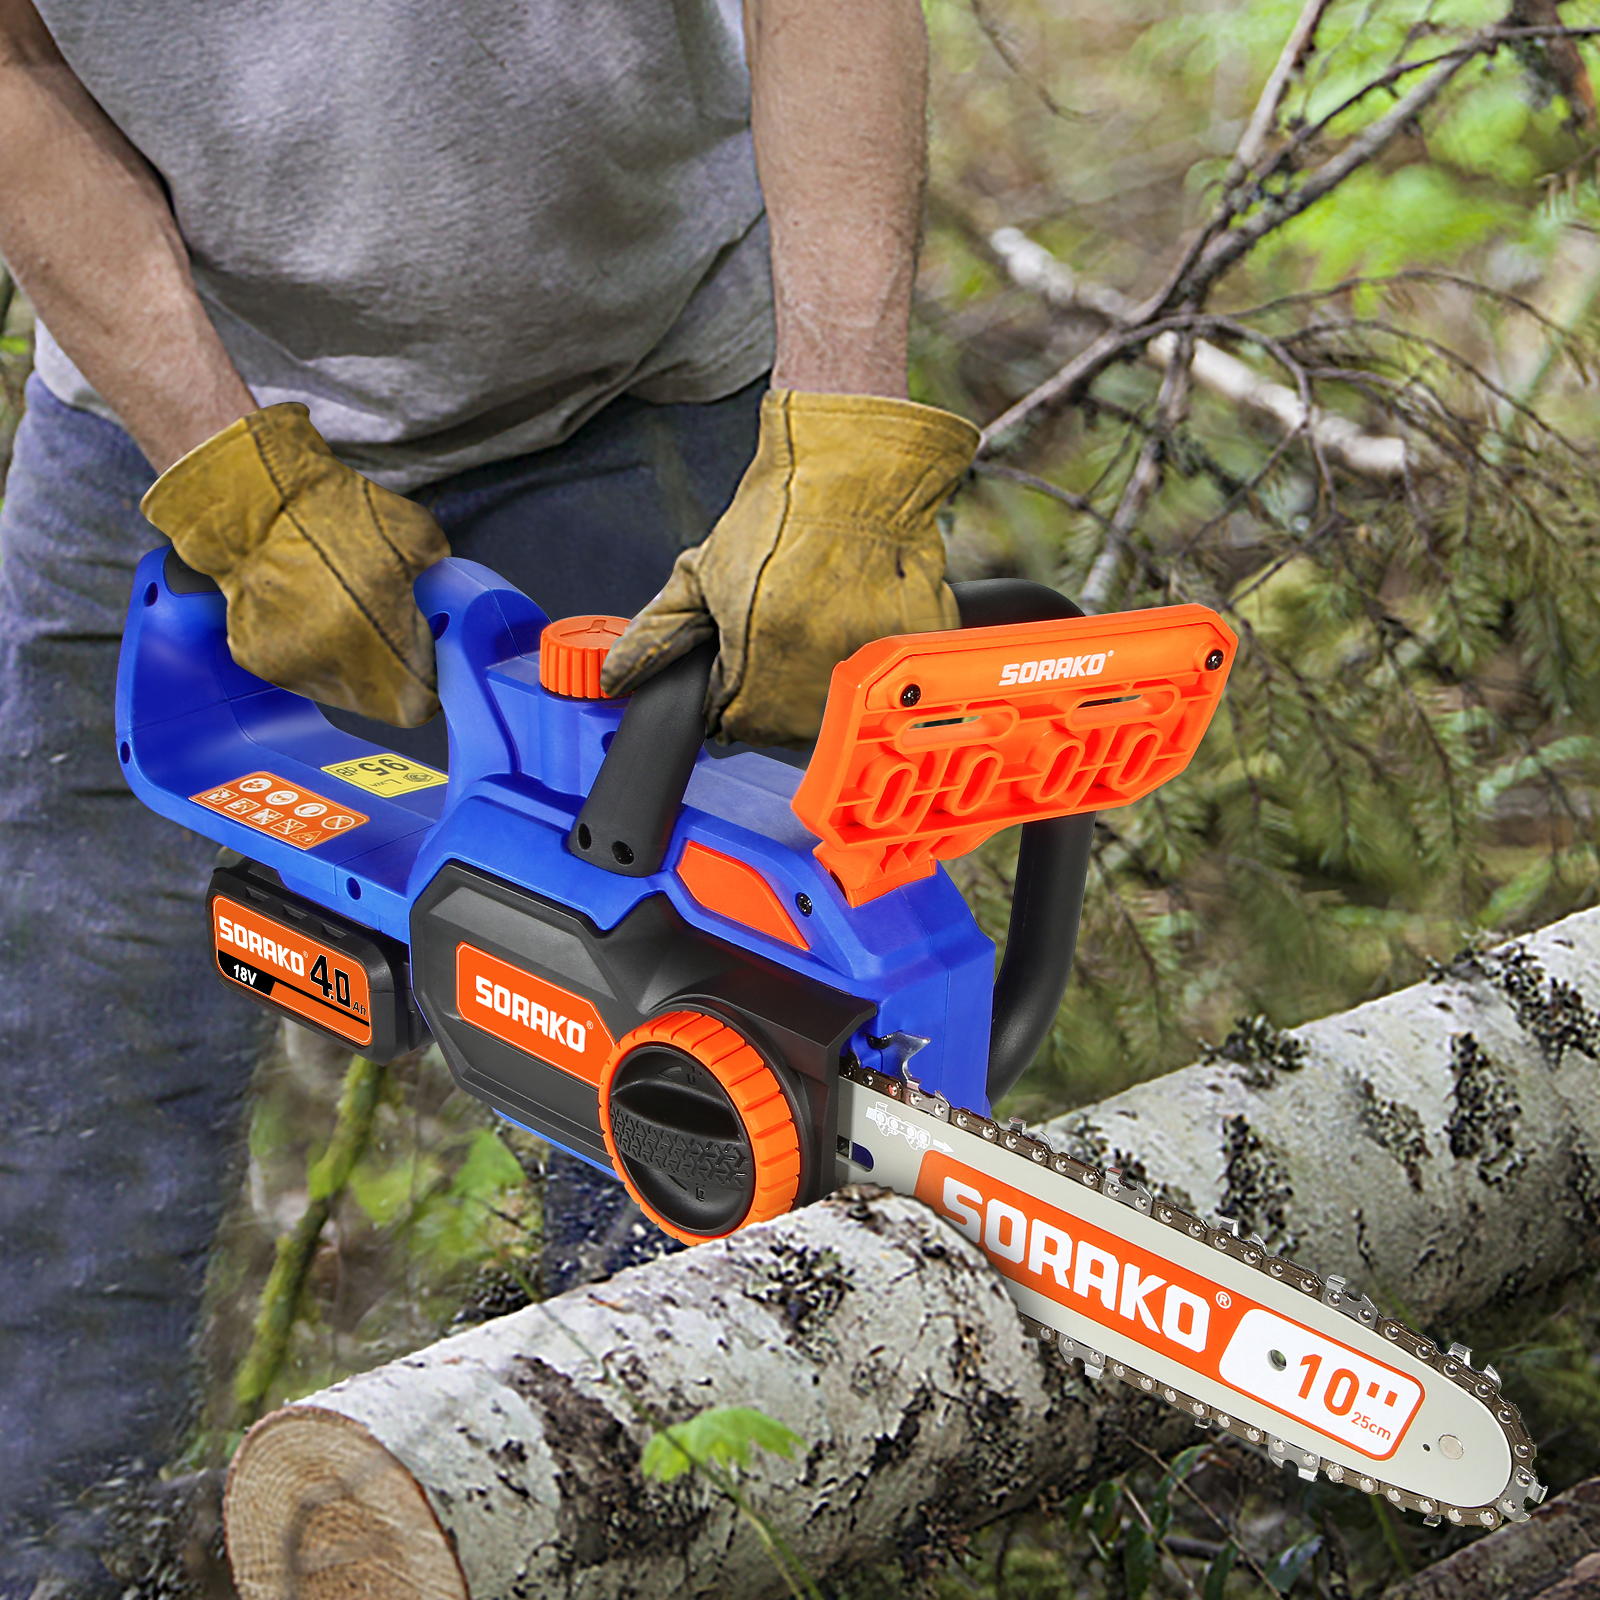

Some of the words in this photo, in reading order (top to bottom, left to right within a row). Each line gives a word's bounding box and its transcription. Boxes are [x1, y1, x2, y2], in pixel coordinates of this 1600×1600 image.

[357, 758, 409, 776] 95
[233, 964, 257, 986] 18V
[1350, 1411, 1392, 1441] 25cm
